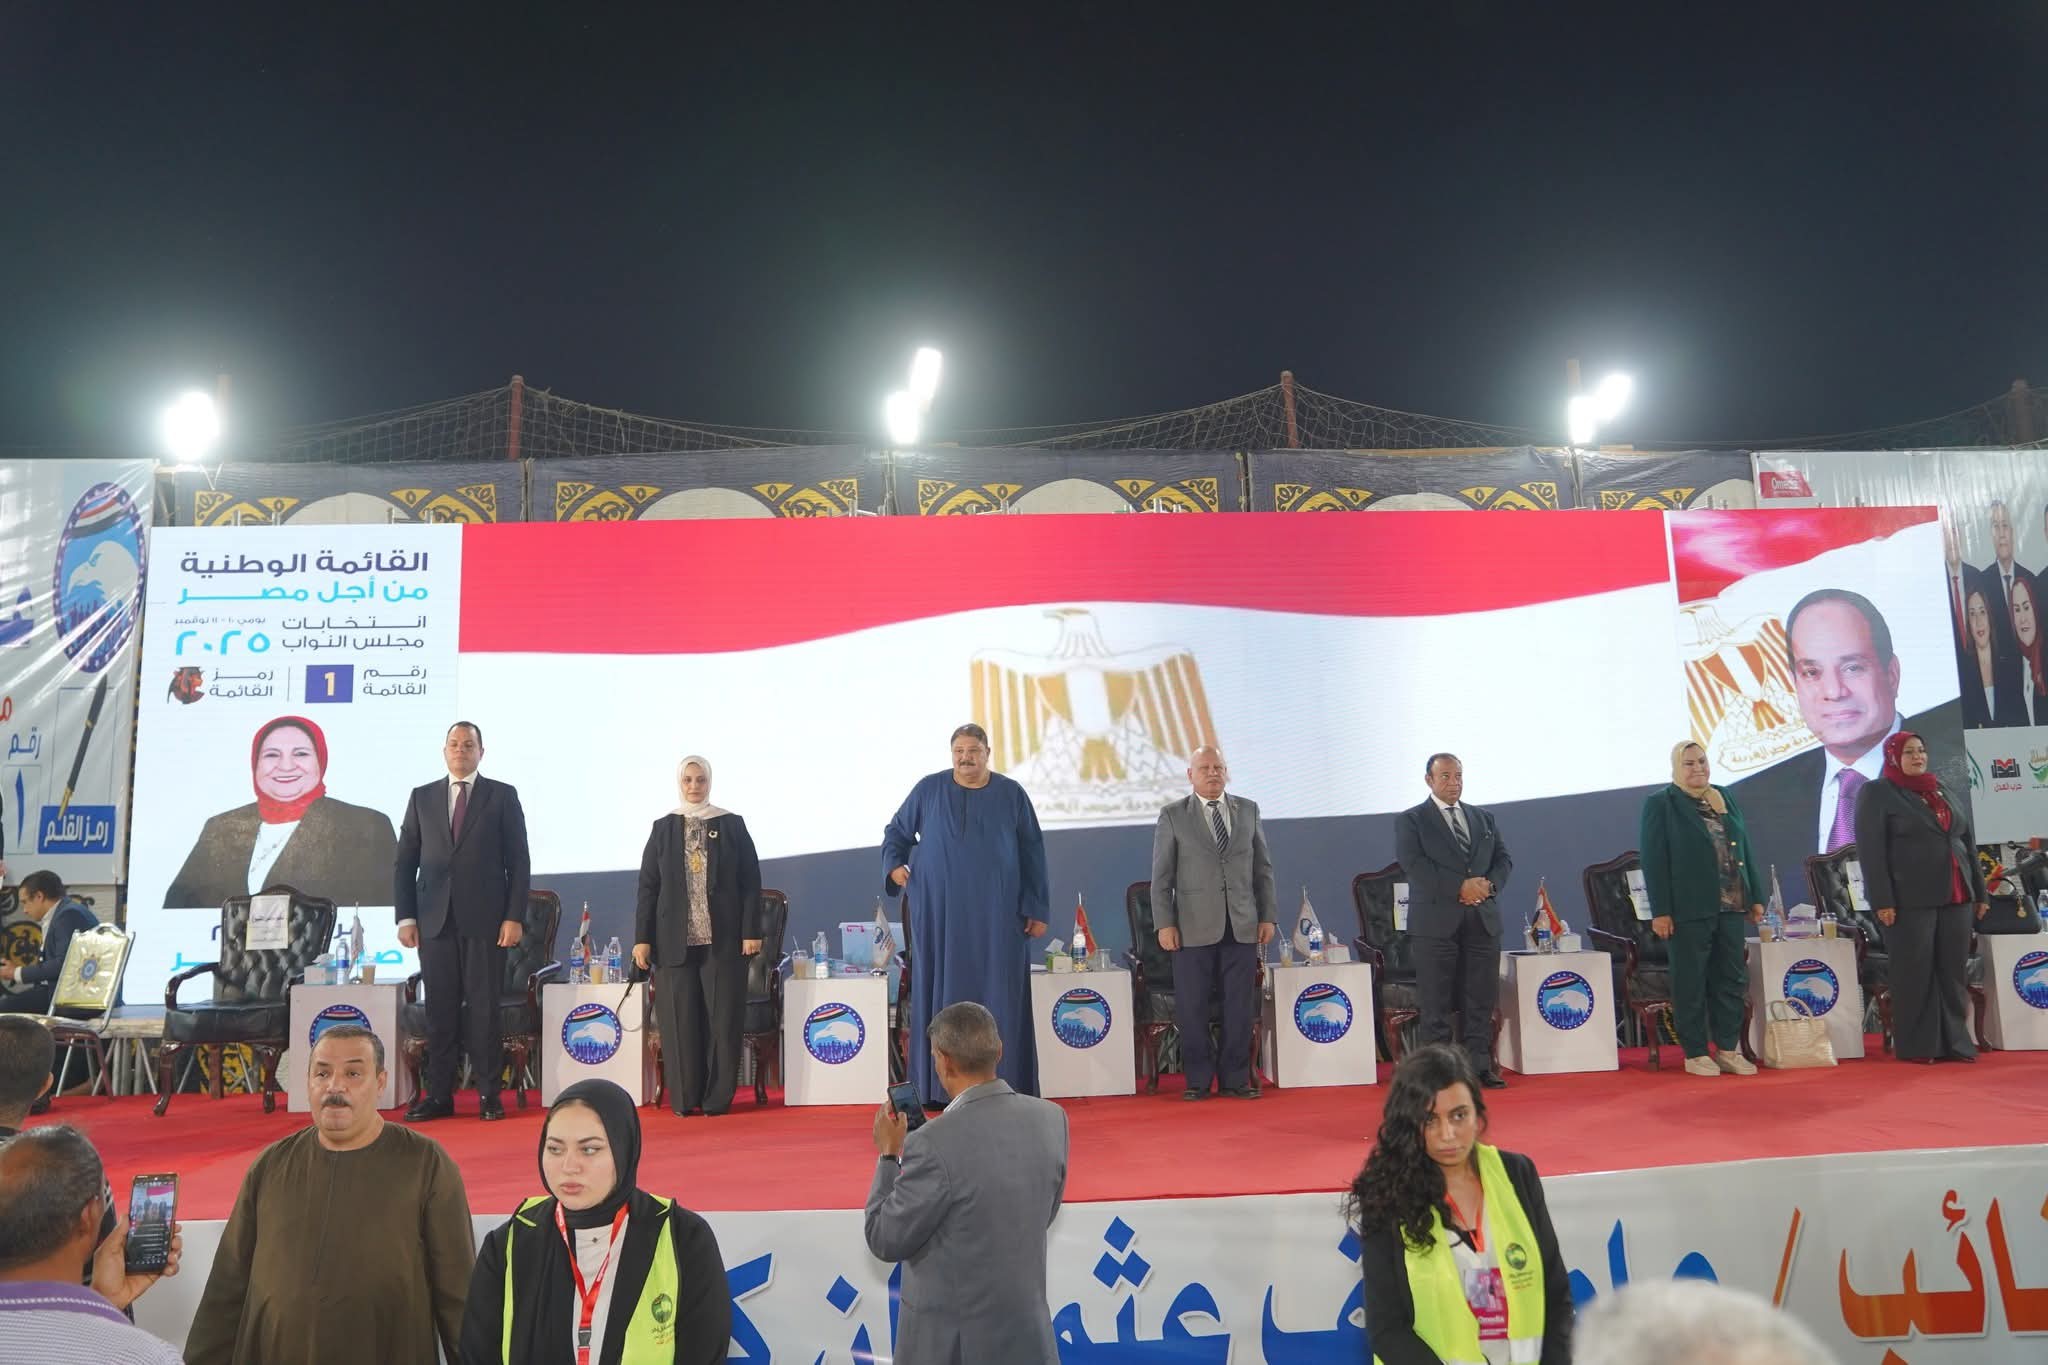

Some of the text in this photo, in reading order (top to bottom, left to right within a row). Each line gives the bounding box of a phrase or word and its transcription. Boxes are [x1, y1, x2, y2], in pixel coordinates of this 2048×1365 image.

[180, 550, 428, 578] القائمة الوطنية
[178, 576, 428, 605] من أجل مصر
[282, 615, 427, 630] انتخابات
[175, 630, 271, 656] ٢٠٢٥
[282, 635, 424, 651] مجلس النواب
[213, 667, 274, 682] رمز
[324, 672, 335, 696] 1
[363, 666, 427, 682] رقم
[209, 682, 273, 698] القائمة
[362, 682, 427, 697] القائمة
[8, 726, 41, 760] رقم
[44, 813, 109, 848] رمز القلم
